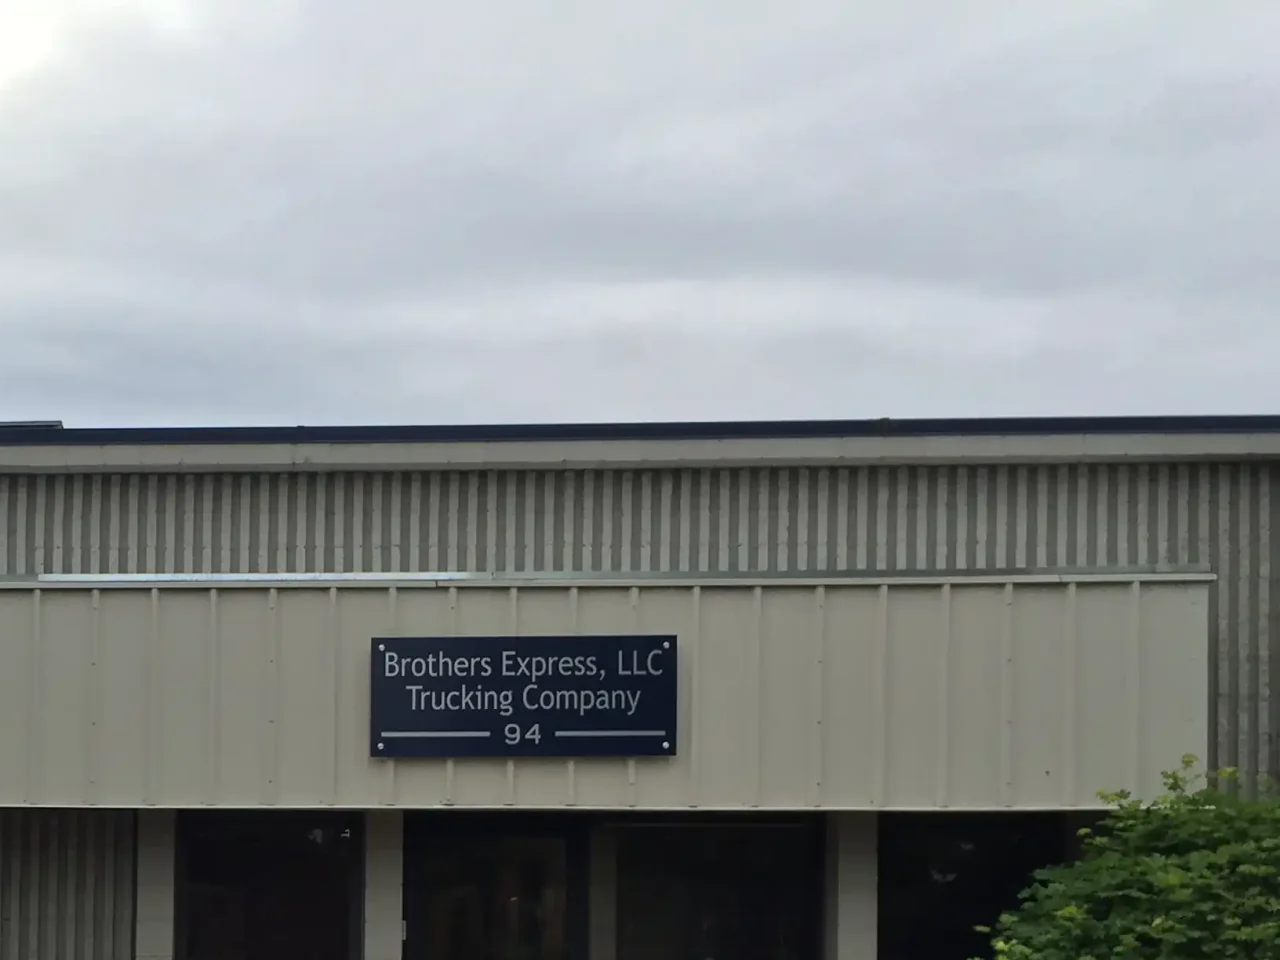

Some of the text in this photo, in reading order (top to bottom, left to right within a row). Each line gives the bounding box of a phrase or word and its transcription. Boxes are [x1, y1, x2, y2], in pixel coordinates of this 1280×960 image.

[384, 649, 663, 682] Brothers Express, LLC
[405, 683, 641, 717] Trucking Company
[504, 723, 542, 745] 94
